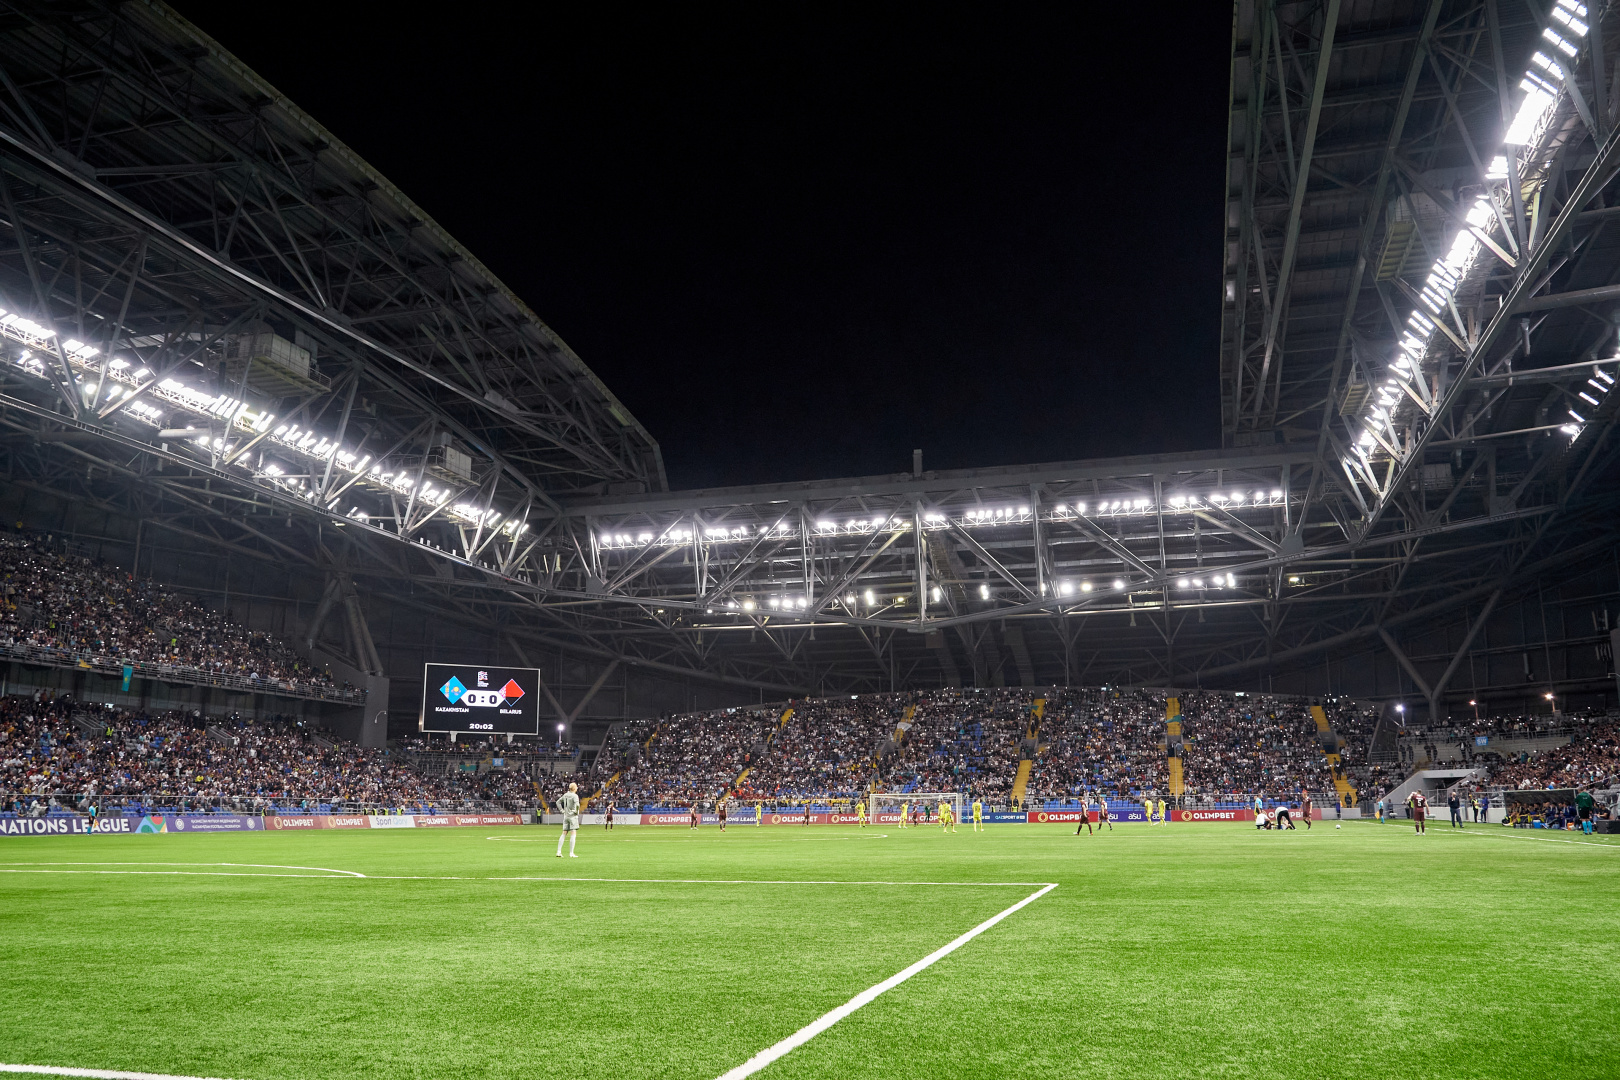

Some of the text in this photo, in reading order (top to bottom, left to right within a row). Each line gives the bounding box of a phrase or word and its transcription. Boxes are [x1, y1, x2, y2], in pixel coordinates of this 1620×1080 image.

[468, 694, 476, 704] 0
[489, 695, 497, 705] 0
[1049, 813, 1081, 821] OLIMPB
[1193, 812, 1235, 820] OLIMPBET
[282, 818, 314, 827] OLIMPBET
[336, 818, 364, 826] OLIMPBET
